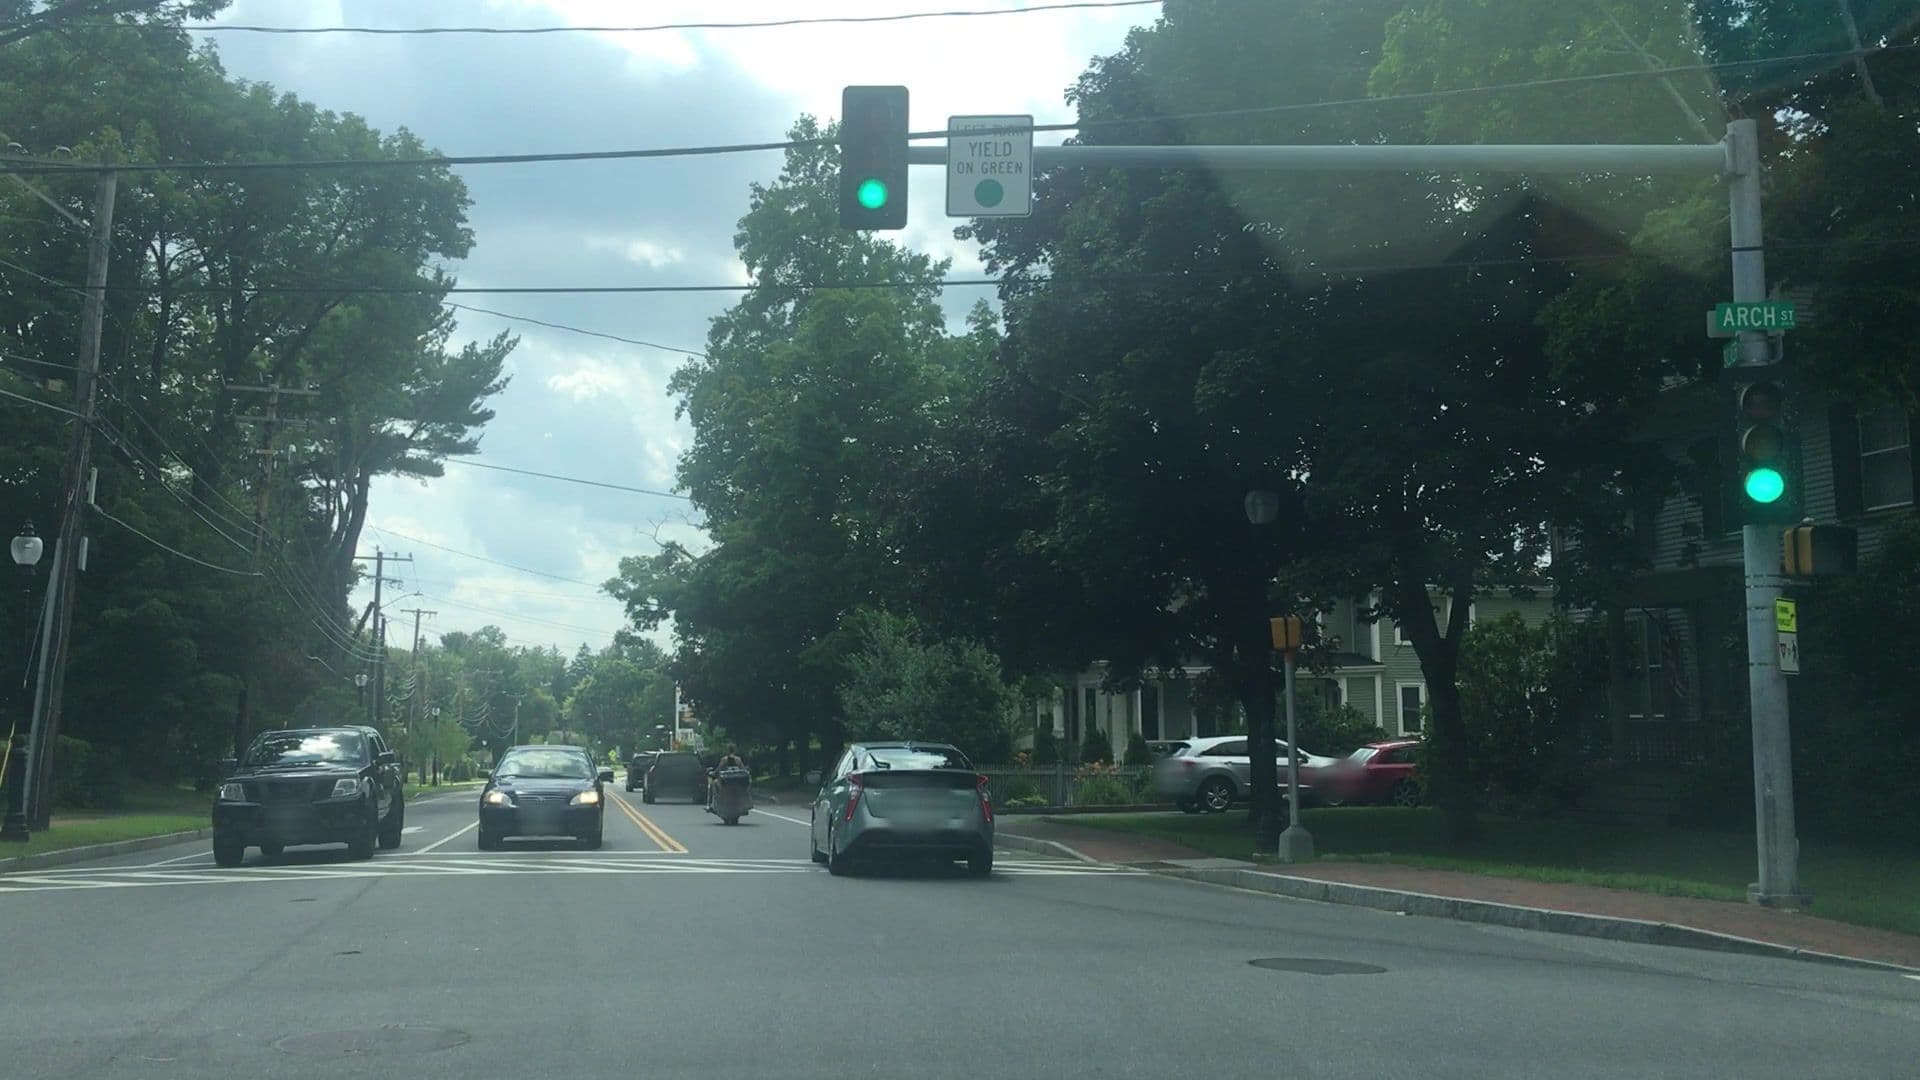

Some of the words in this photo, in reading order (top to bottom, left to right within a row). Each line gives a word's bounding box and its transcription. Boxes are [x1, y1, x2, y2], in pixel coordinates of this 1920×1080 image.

[969, 141, 1012, 157] YIELD
[957, 161, 974, 174] ON
[981, 161, 1023, 174] GREEN
[1723, 306, 1776, 327] ARCH
[1781, 310, 1795, 321] ST
